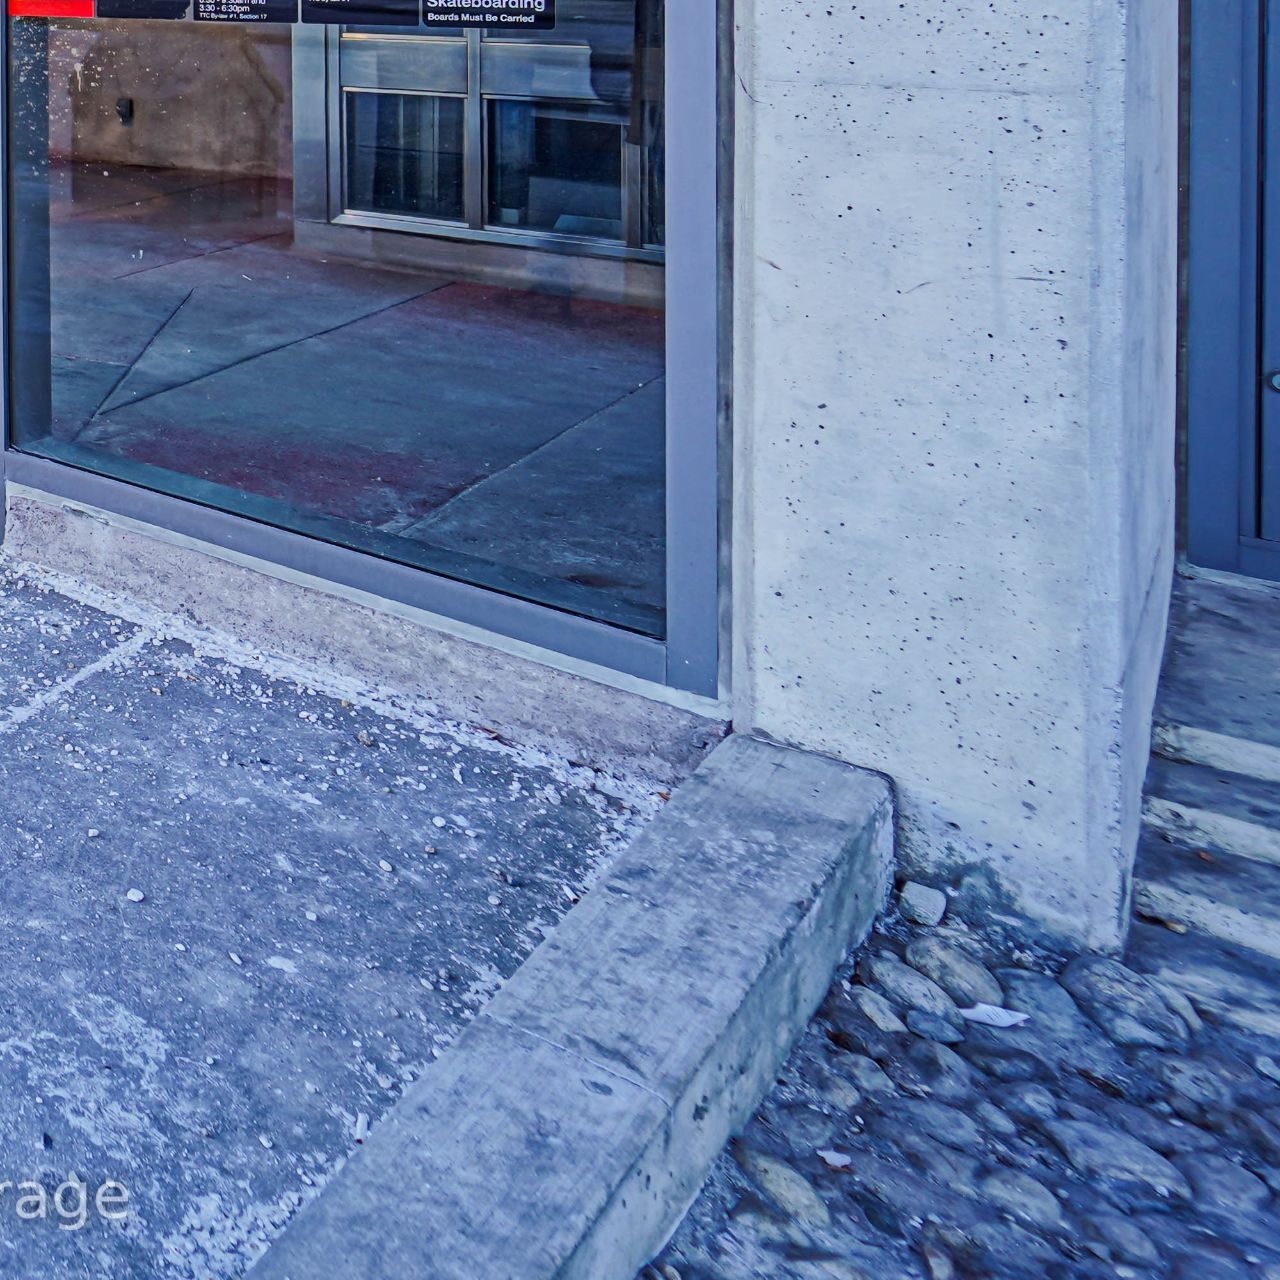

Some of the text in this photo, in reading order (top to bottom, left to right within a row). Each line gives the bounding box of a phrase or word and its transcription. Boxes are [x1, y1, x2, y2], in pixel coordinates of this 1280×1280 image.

[221, 5, 250, 13] 6:30pm
[427, 13, 535, 23] Boards Must Be Carried
